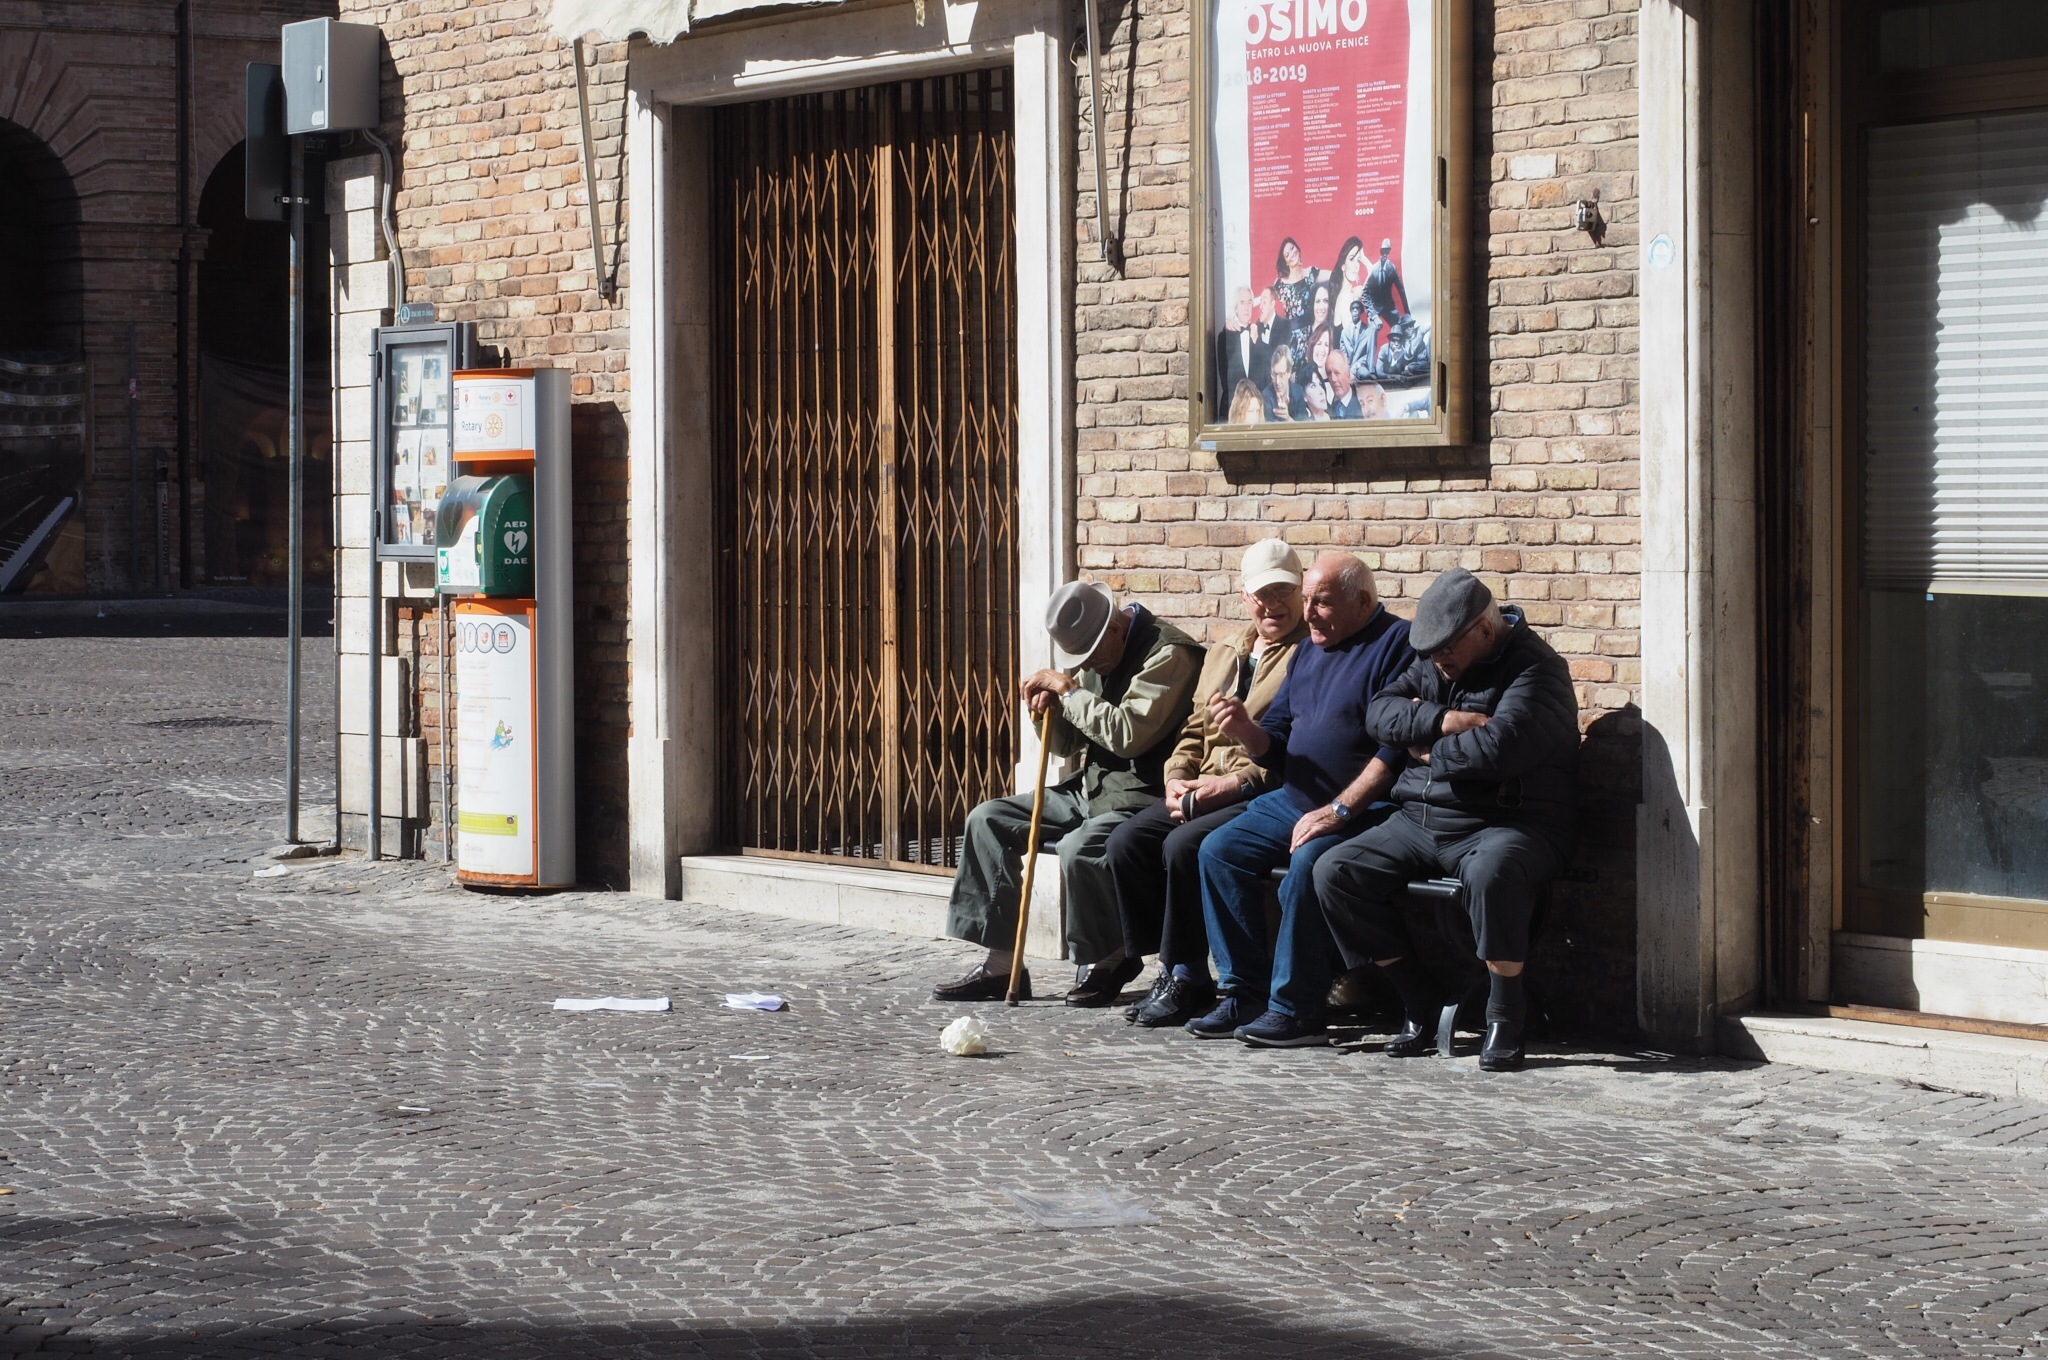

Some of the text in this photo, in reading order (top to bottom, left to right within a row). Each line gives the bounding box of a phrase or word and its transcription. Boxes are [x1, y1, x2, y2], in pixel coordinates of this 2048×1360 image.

[1245, 0, 1368, 44] OSIMO
[1246, 36, 1369, 60] TEATRO LA NUOVA FENICE
[462, 420, 482, 433] Rotary
